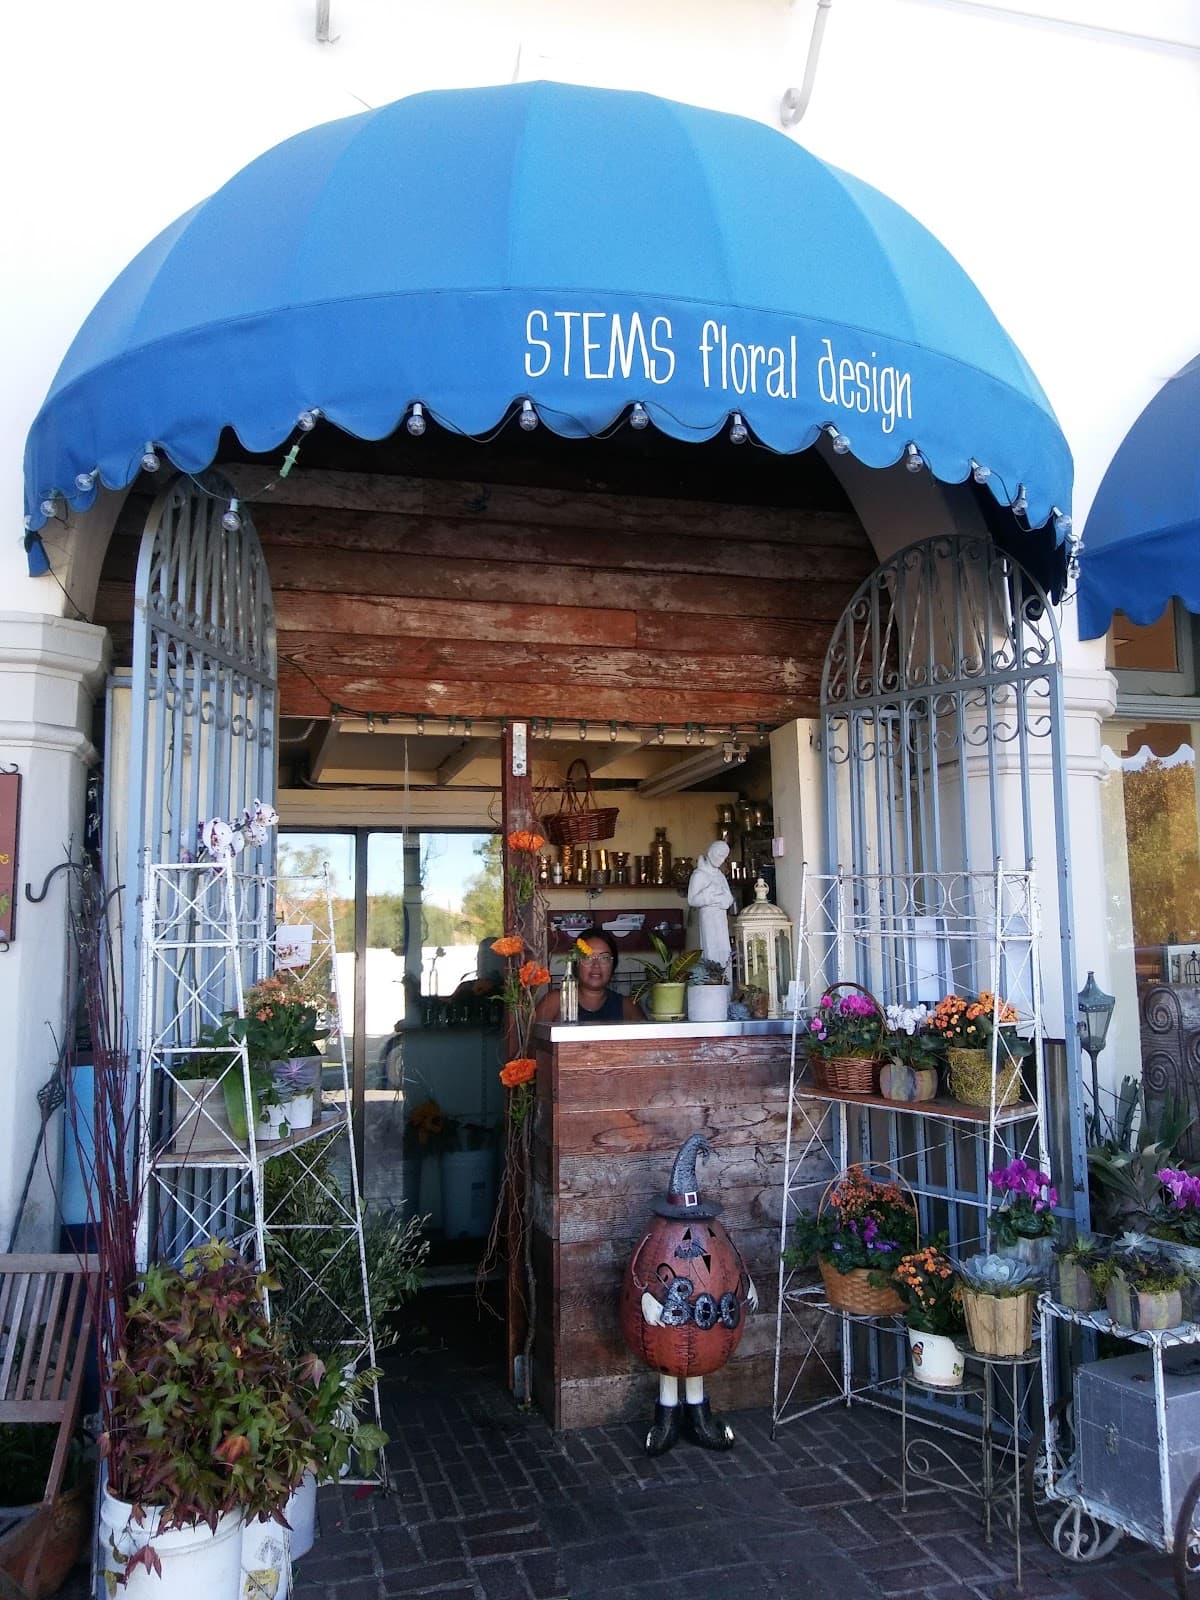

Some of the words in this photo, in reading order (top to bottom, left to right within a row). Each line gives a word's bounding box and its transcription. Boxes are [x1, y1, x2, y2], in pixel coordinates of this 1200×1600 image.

[525, 310, 675, 384] STEMS
[699, 320, 798, 399] floral
[818, 339, 912, 434] design
